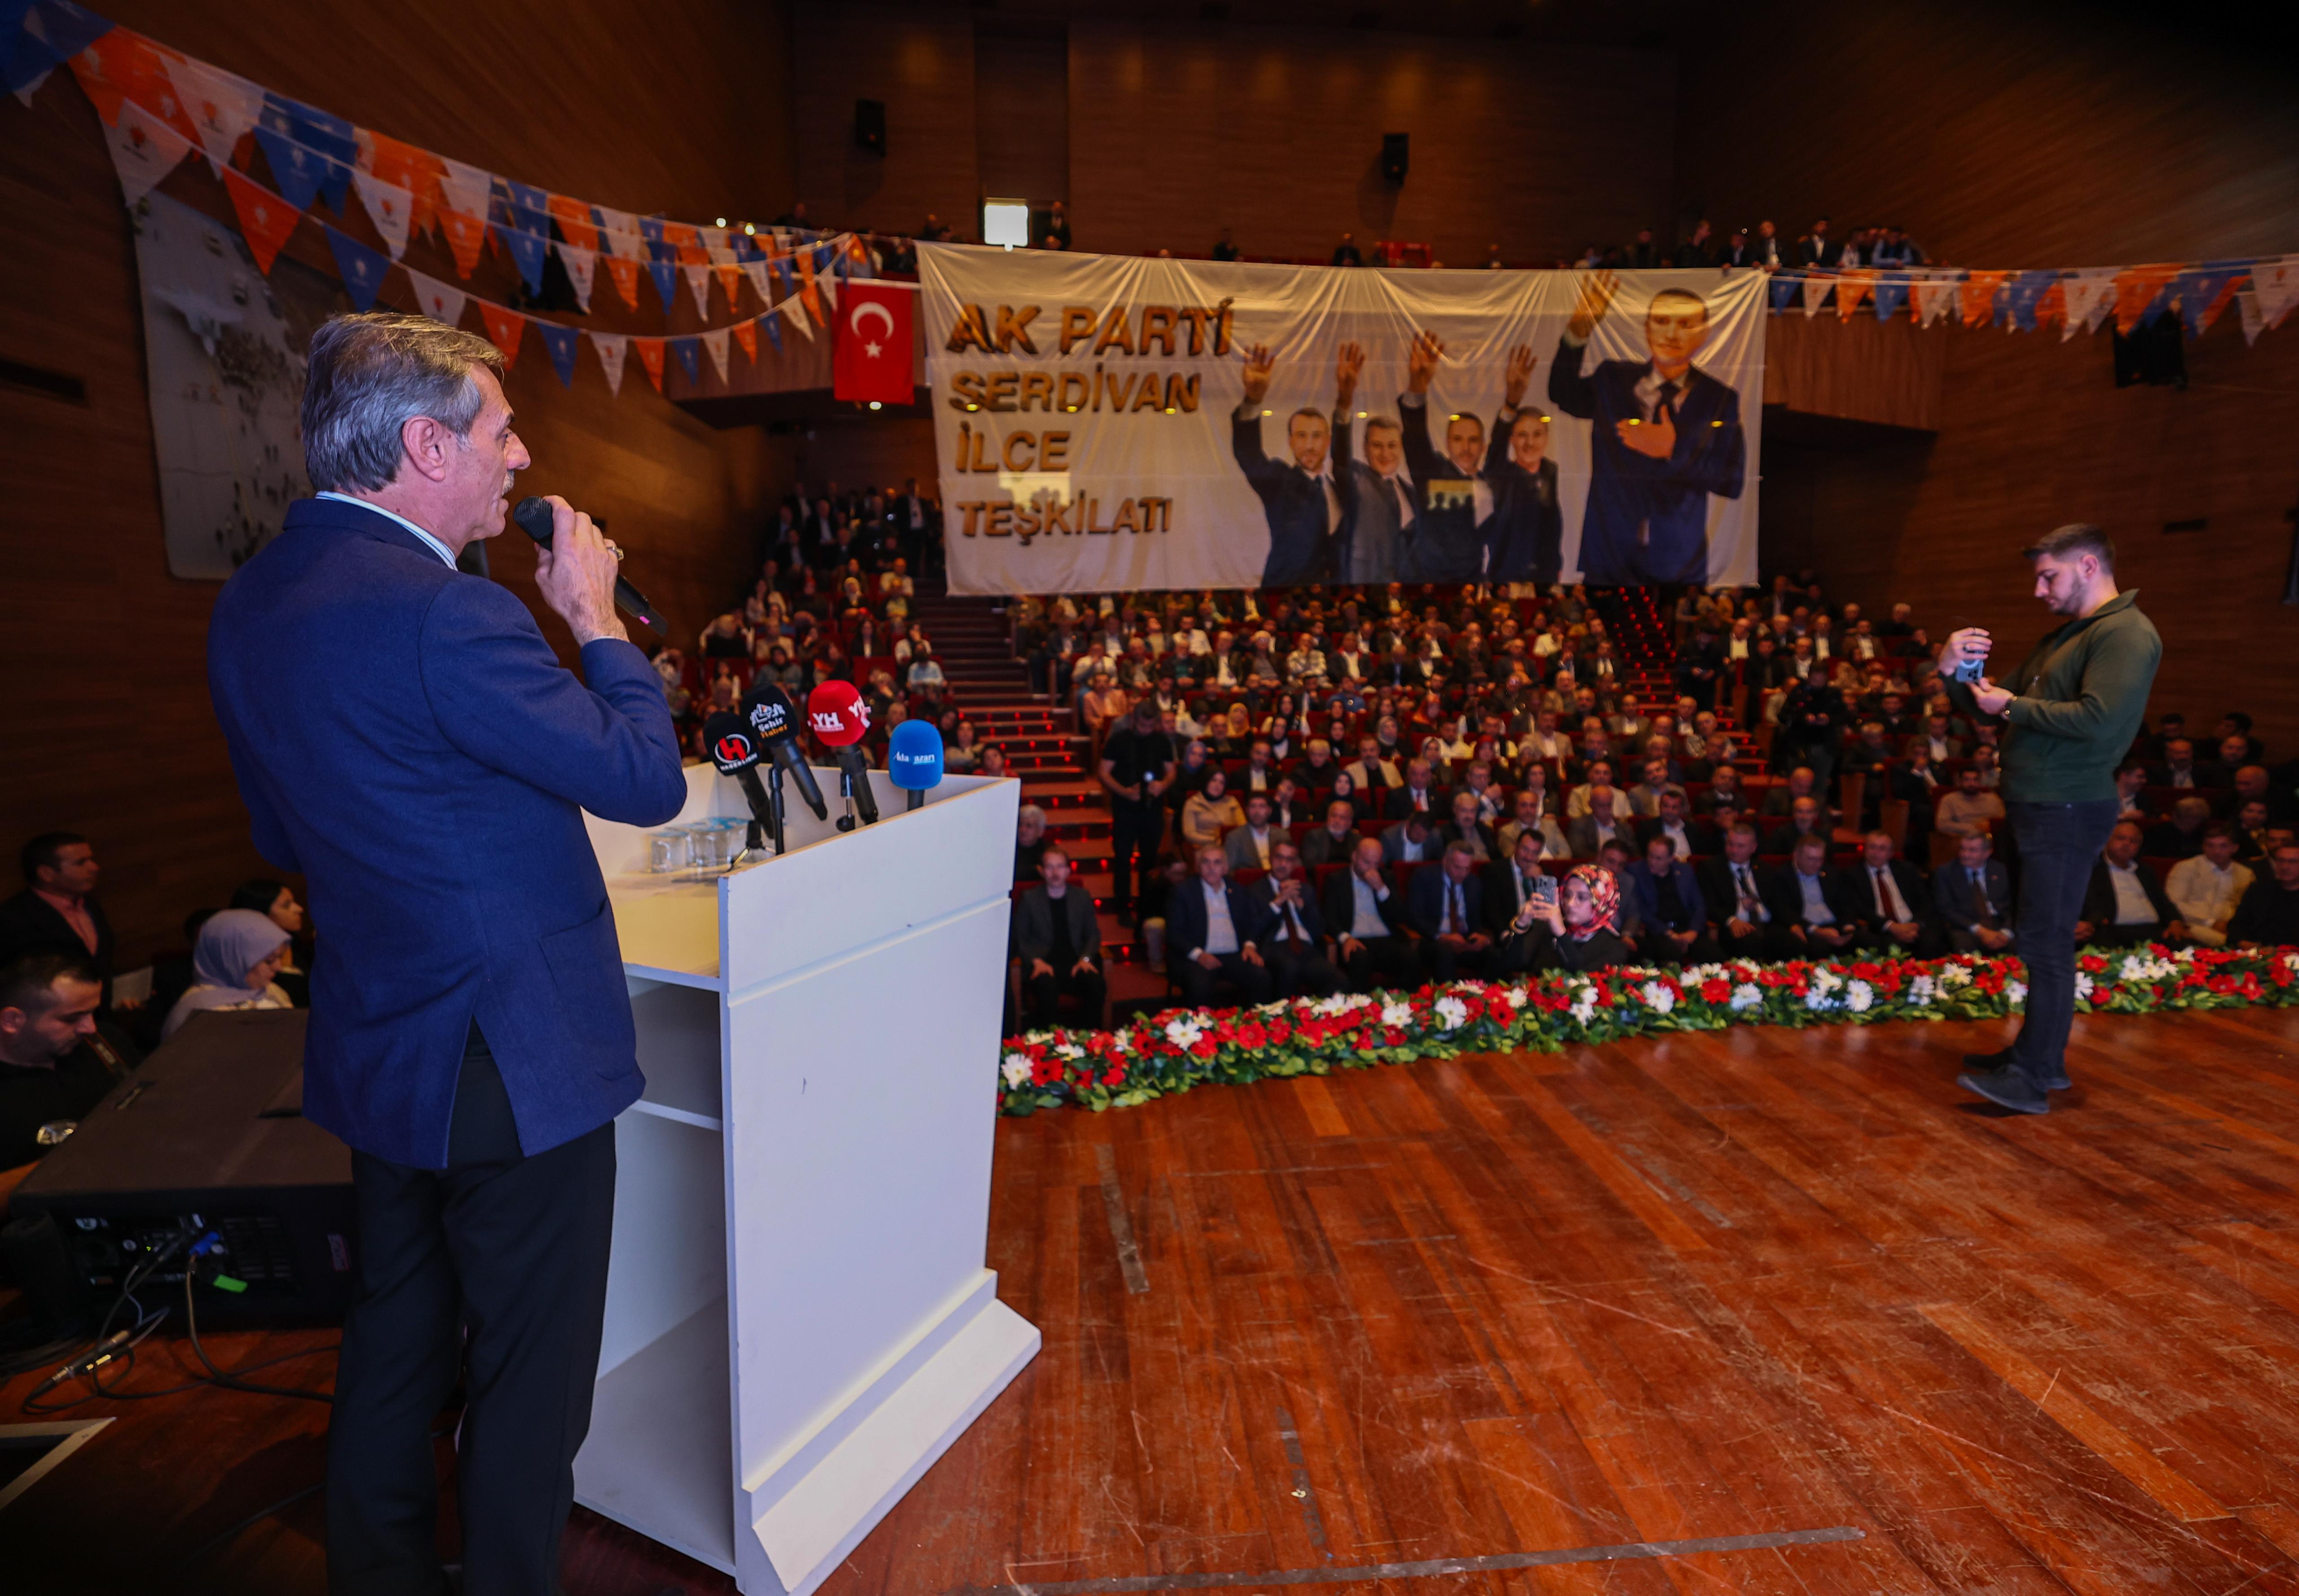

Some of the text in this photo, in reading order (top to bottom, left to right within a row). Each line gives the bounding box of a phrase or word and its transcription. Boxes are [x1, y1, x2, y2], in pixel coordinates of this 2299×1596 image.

[945, 296, 1234, 356] AK PARTİ
[948, 362, 1201, 414] SERDİVAN
[956, 489, 1173, 546] TEŞKİLATI
[812, 712, 840, 727] YH
[718, 737, 747, 761] H
